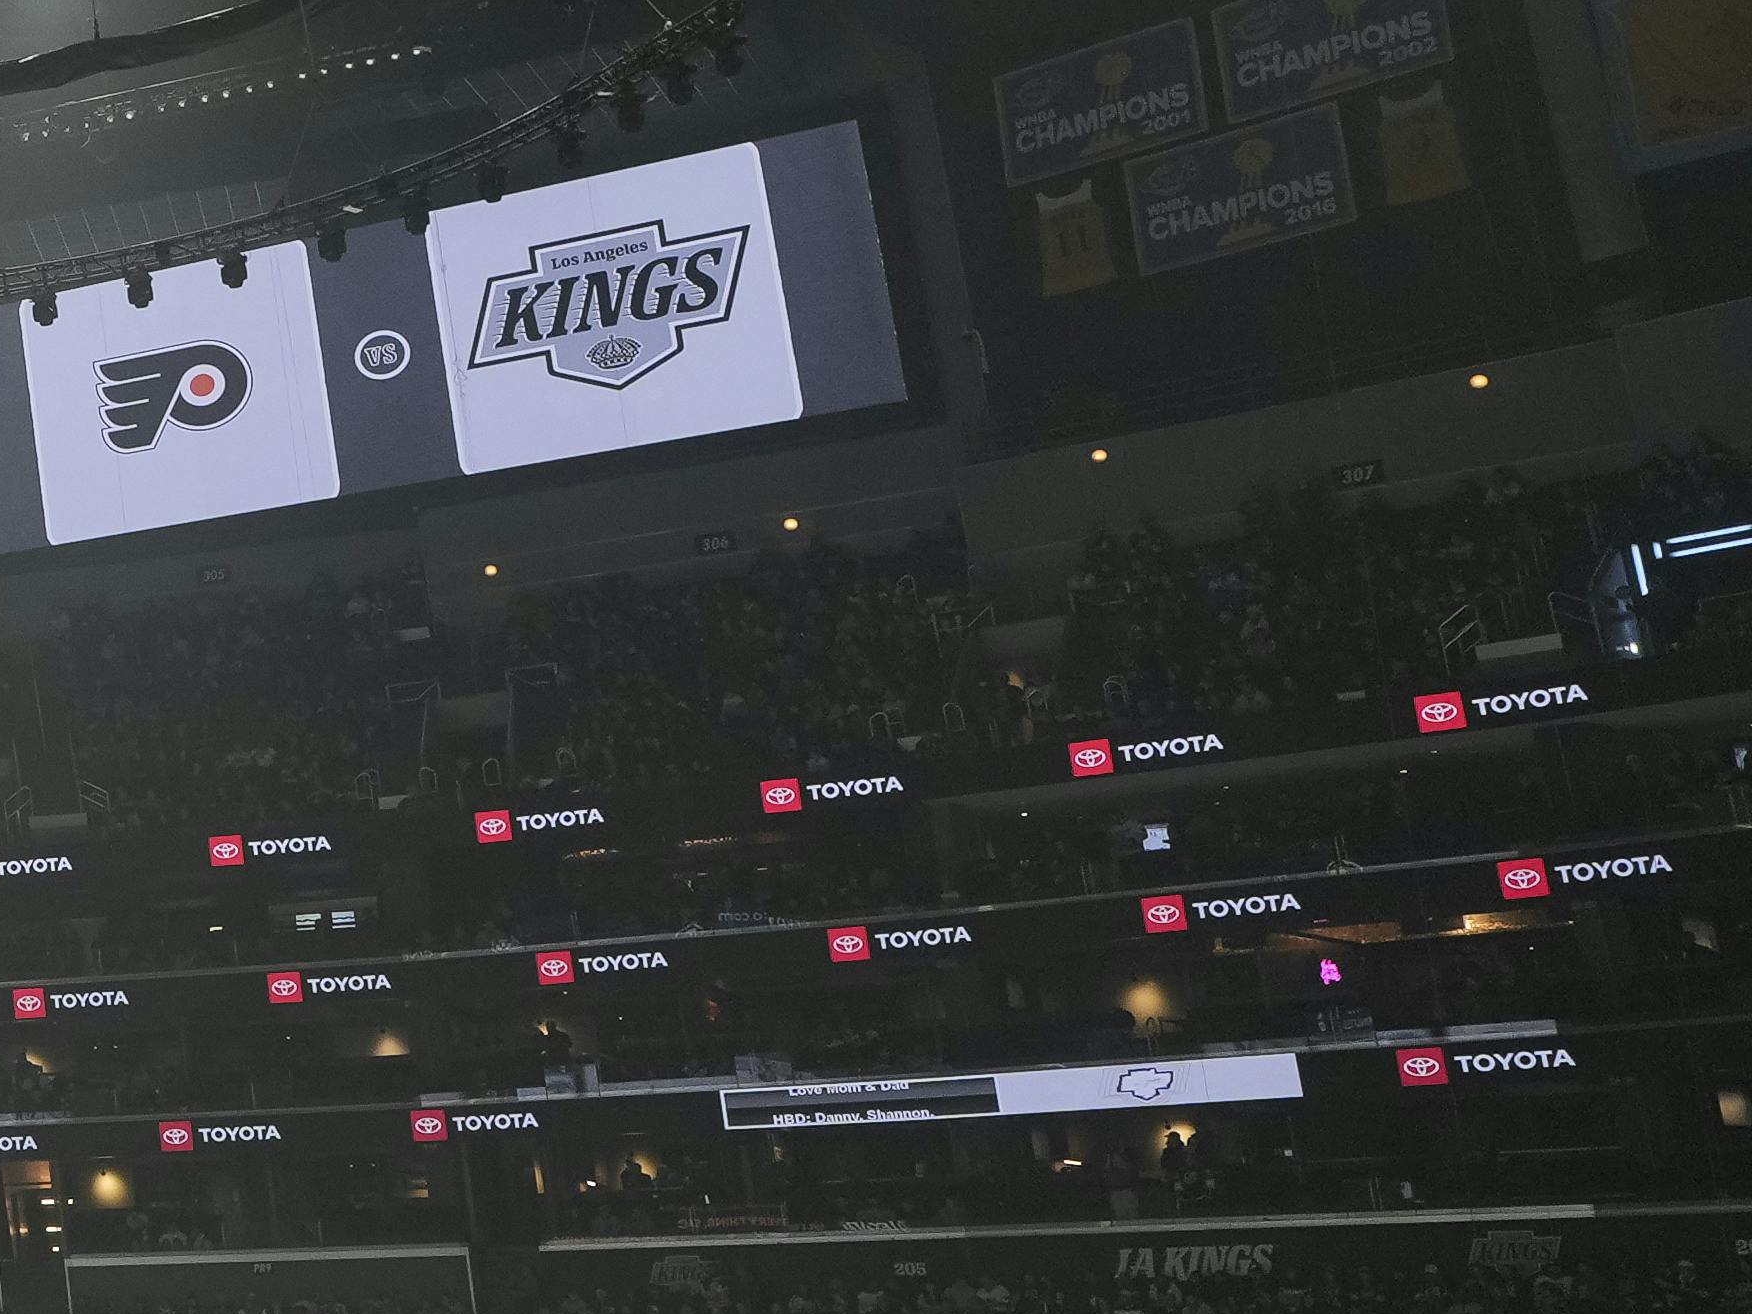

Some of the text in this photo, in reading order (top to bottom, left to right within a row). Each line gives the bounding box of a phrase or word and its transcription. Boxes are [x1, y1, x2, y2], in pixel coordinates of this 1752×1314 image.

[1237, 10, 1432, 87] CHAMPIONS
[1015, 84, 1190, 153] CHAMPIONS
[1148, 171, 1334, 240] CHAMPIONS
[551, 240, 648, 270] Los Angeles
[495, 247, 722, 348] KINGS
[364, 343, 398, 366] VS
[1342, 465, 1375, 483] 307
[1472, 685, 1588, 715] TOYOTA
[1118, 734, 1223, 761] TOYOTA
[517, 809, 604, 830] TOYOTA
[249, 836, 331, 855] TOYOTA
[875, 927, 971, 949] TOYOTA
[579, 952, 668, 973] TOYOTA
[308, 975, 391, 993] TOYOTA
[51, 991, 129, 1008] TOYOTA
[1454, 1050, 1573, 1072] TOYOTA
